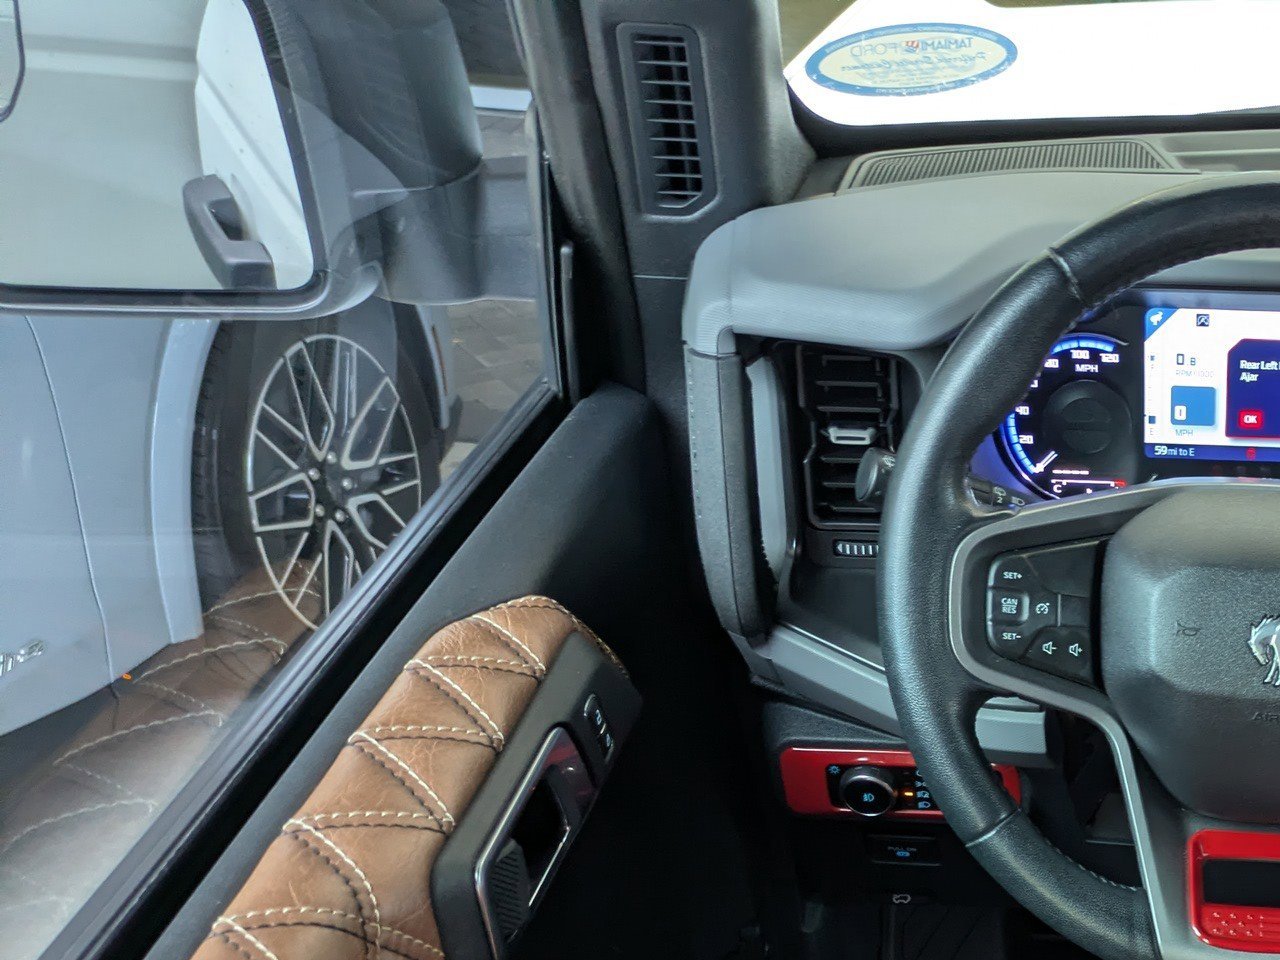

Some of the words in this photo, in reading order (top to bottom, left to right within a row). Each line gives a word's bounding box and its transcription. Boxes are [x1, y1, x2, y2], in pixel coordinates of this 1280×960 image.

[1070, 349, 1090, 360] 100
[1100, 353, 1120, 363] 120
[1075, 363, 1099, 373] MPH
[1239, 359, 1260, 370] Rear
[1260, 360, 1278, 371] Left
[1239, 372, 1259, 382] Ajar
[1243, 414, 1258, 424] OK
[1019, 435, 1034, 444] 20
[1179, 447, 1188, 456] to
[1189, 447, 1195, 456] E
[1001, 597, 1018, 605] CAN
[1002, 606, 1017, 614] RES
